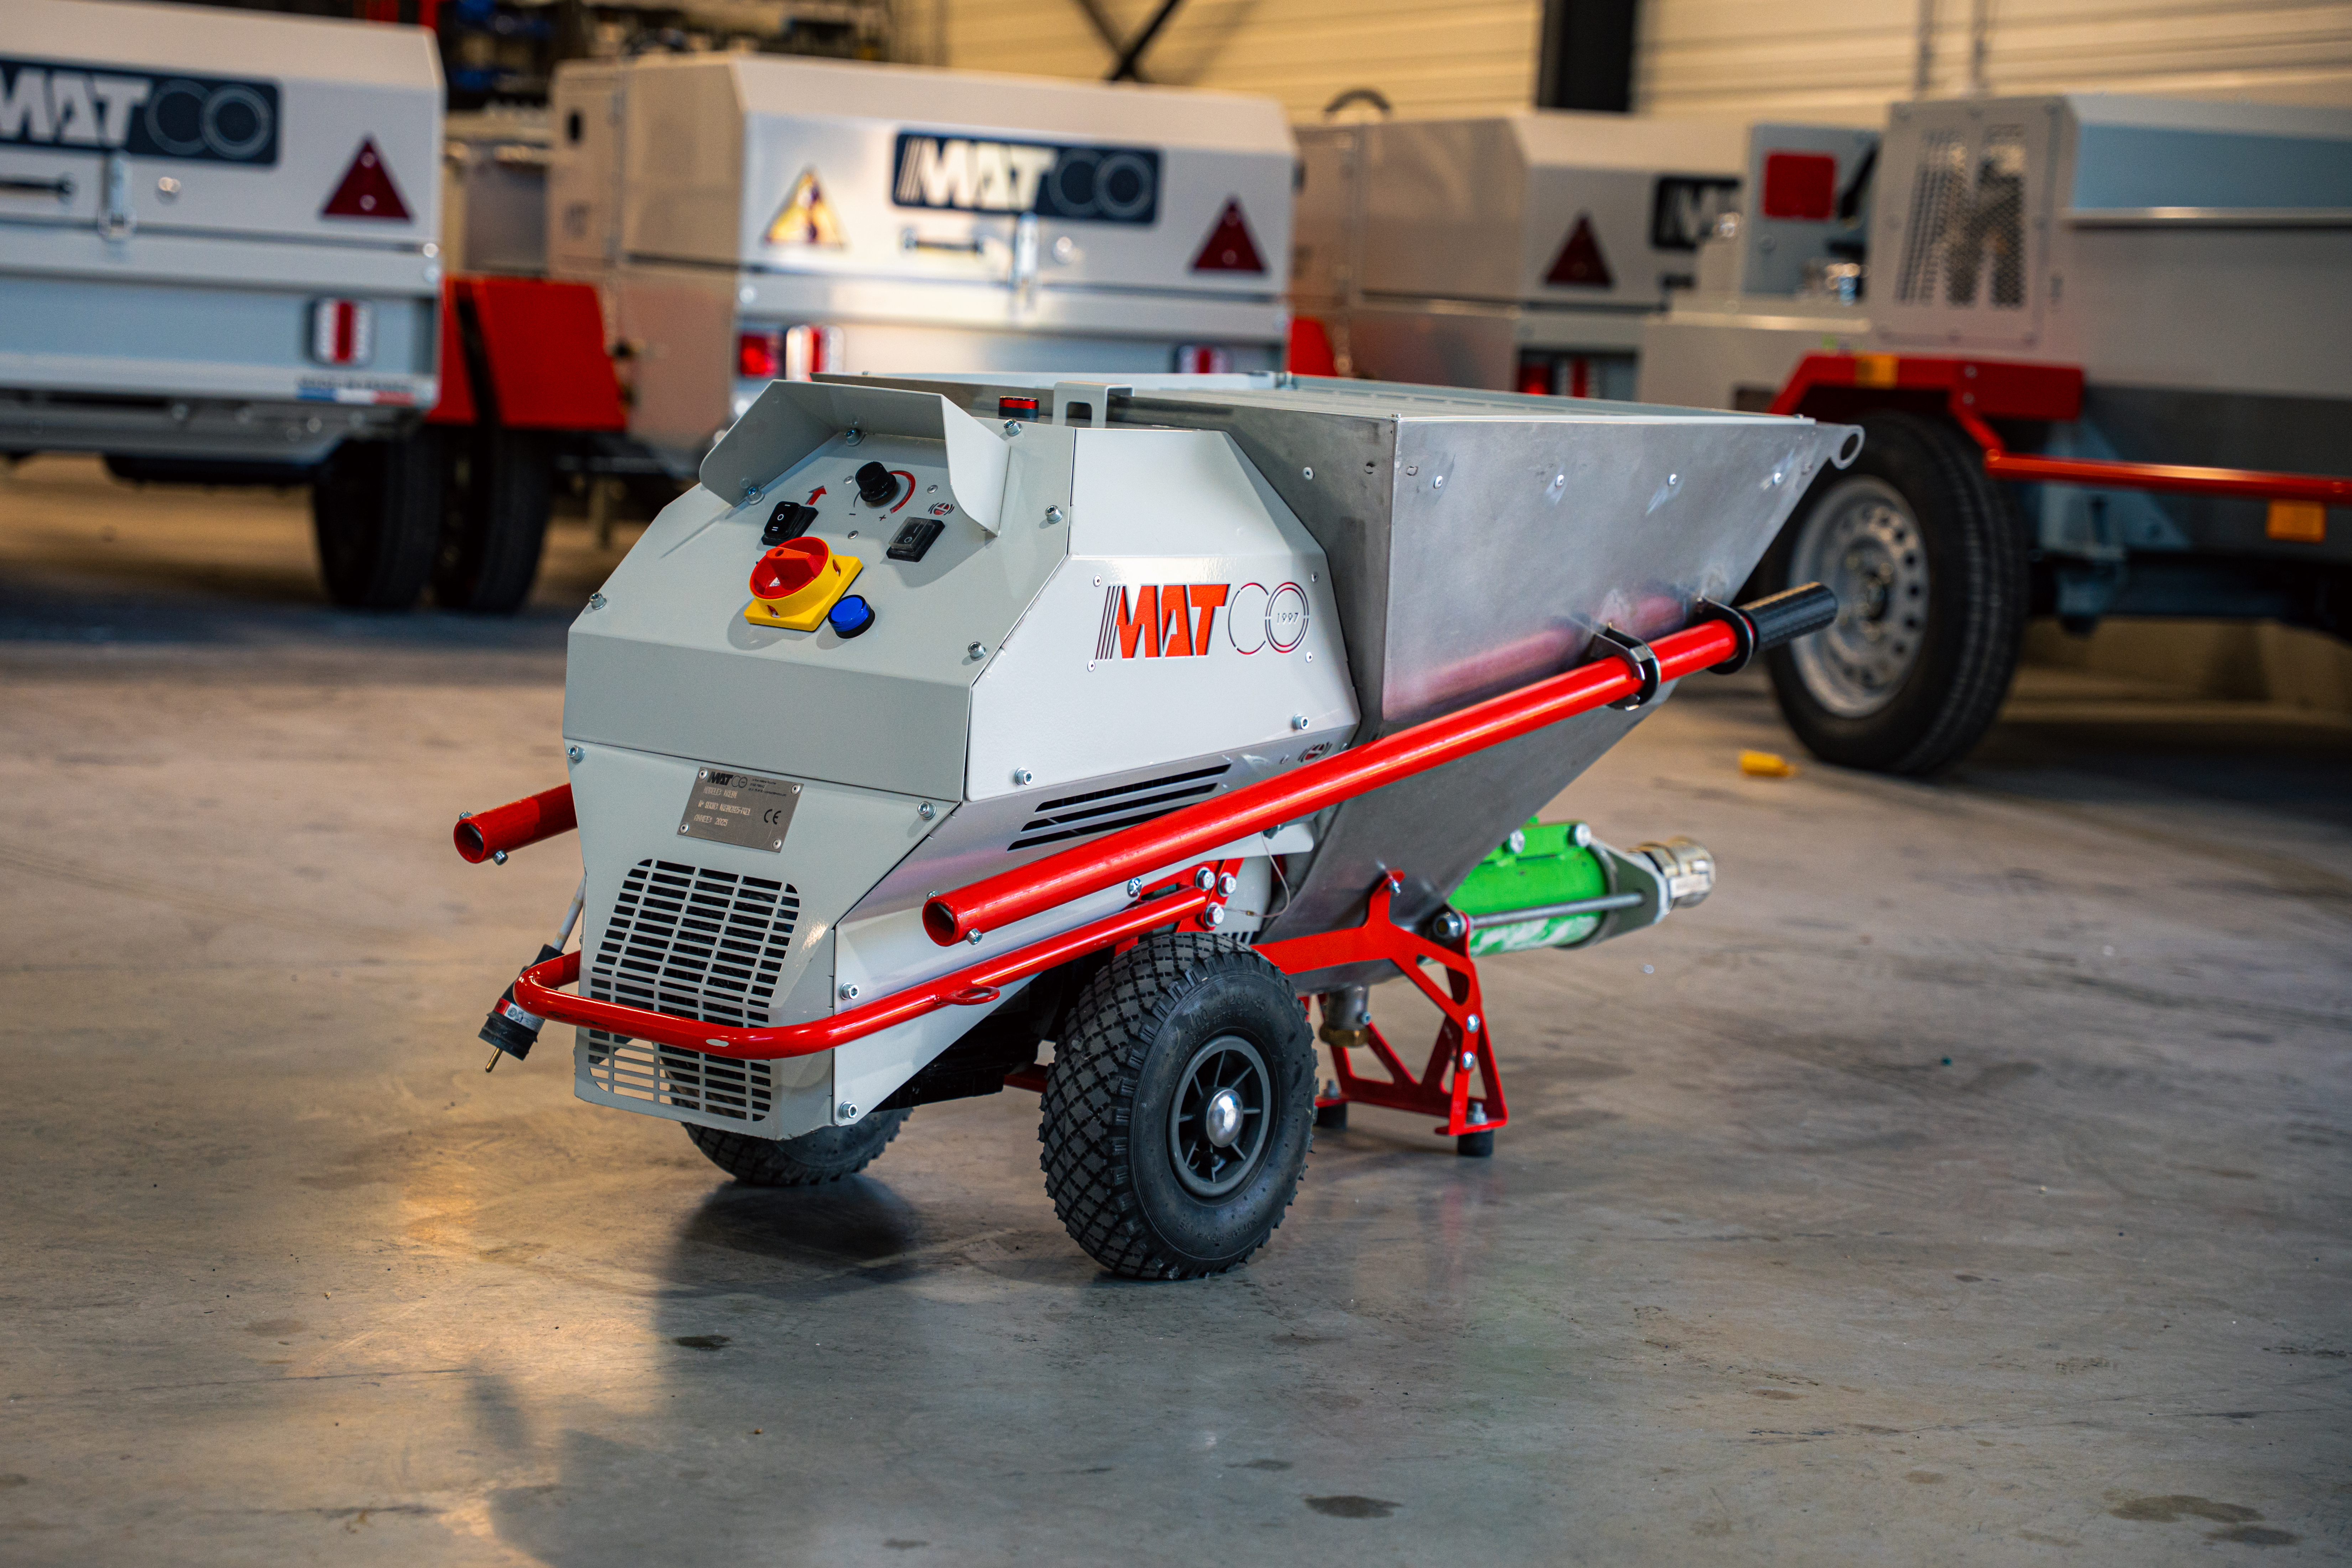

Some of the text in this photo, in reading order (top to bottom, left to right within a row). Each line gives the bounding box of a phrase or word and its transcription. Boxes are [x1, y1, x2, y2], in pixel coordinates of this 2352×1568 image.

[916, 137, 1154, 219] MATCO
[1096, 582, 1310, 660] MATCO
[1276, 612, 1300, 624] 1997
[707, 771, 748, 788] MATCO
[714, 818, 728, 826] 2025
